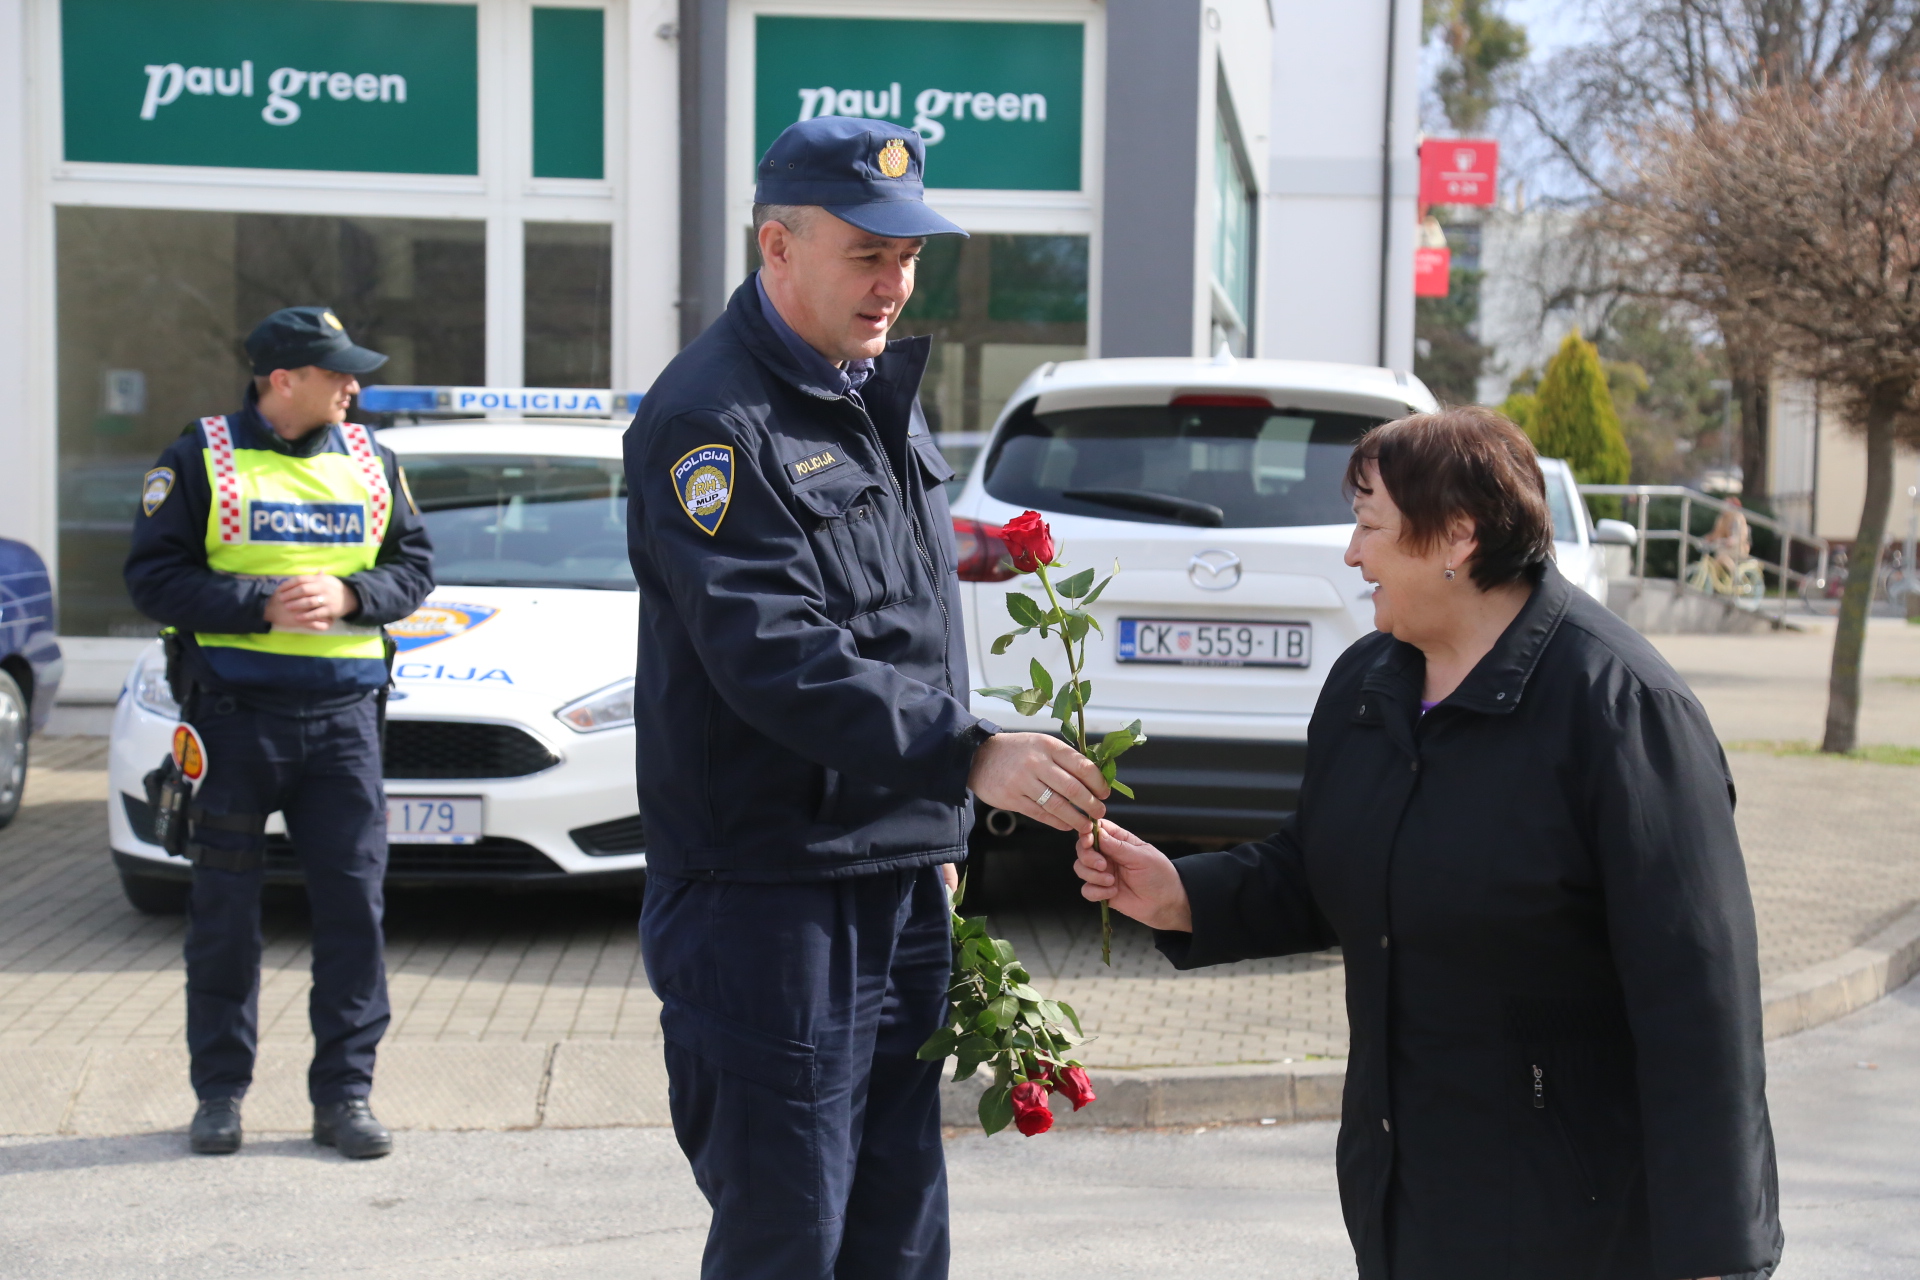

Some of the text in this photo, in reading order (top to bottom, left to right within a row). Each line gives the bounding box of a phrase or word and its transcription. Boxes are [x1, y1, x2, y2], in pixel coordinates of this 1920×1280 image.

[139, 60, 407, 126] paul green
[911, 87, 1047, 146] green
[460, 393, 601, 409] POLICIJA
[675, 450, 730, 479] POLICIJA
[795, 451, 836, 477] POLICIJA
[695, 479, 717, 497] RH
[696, 493, 719, 506] MUP
[253, 510, 362, 535] POLICIJA
[1139, 625, 1172, 655] CK
[396, 663, 515, 685] CIJA
[403, 803, 455, 832] 179
